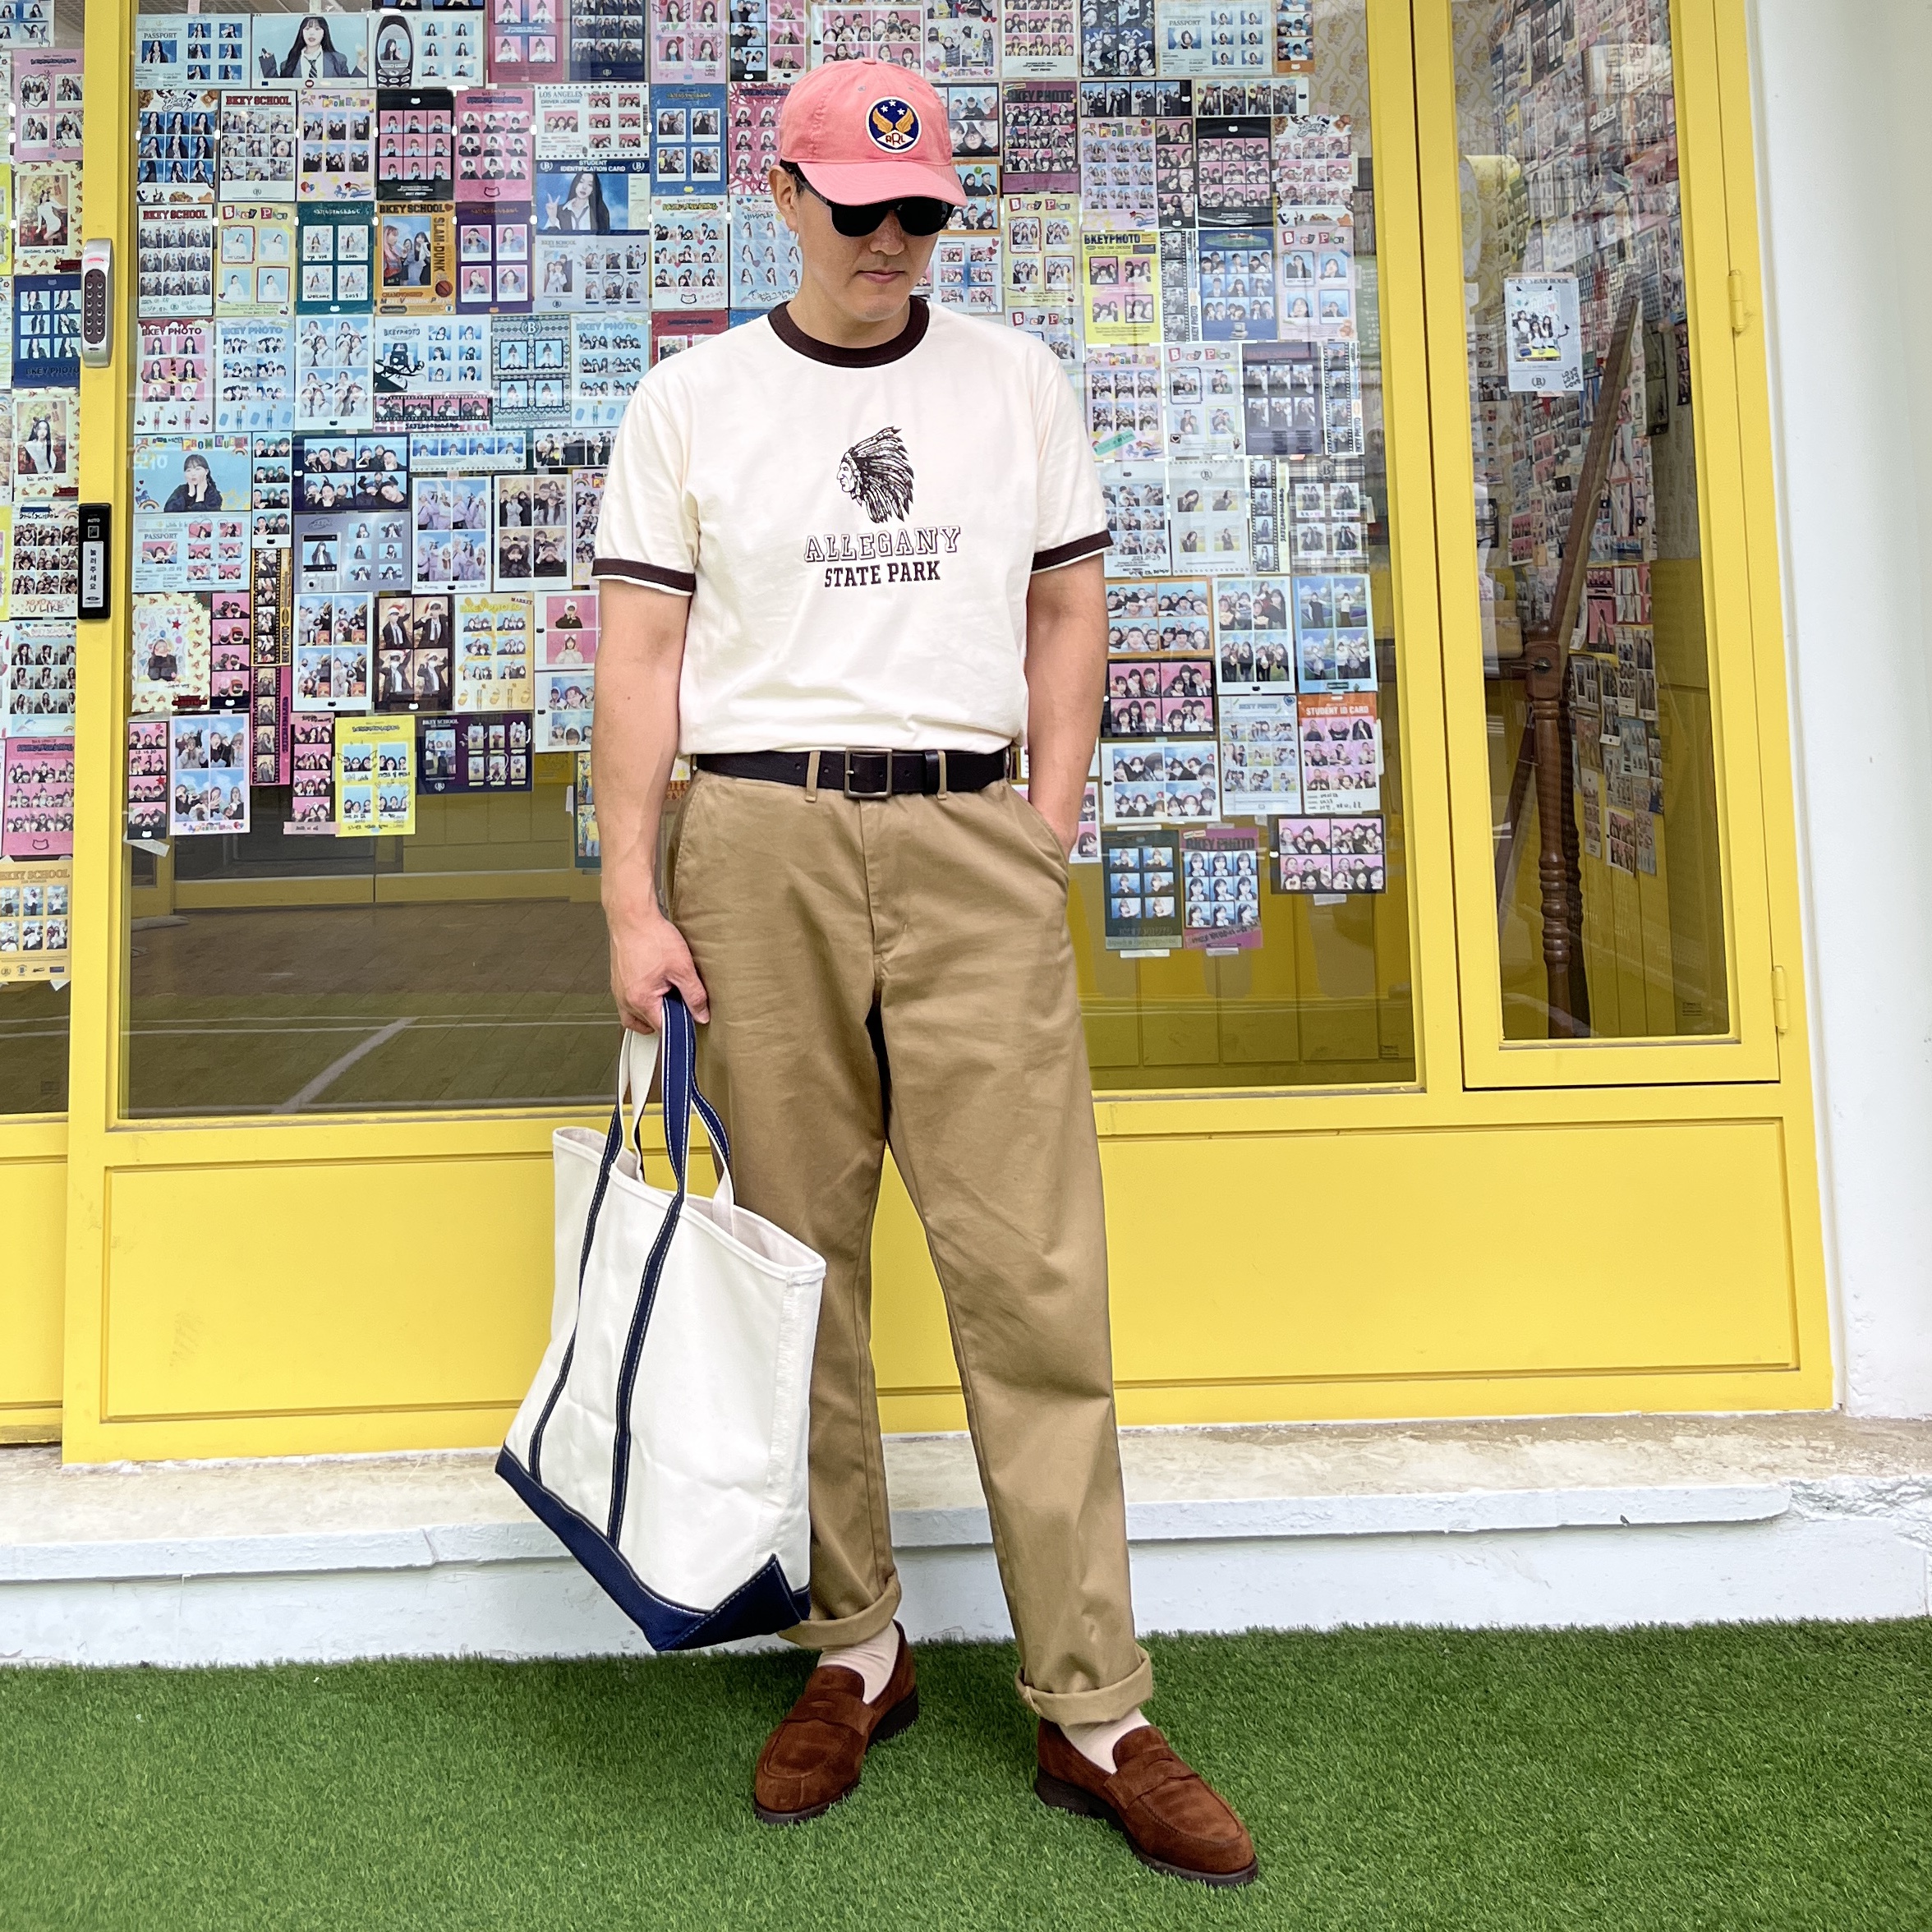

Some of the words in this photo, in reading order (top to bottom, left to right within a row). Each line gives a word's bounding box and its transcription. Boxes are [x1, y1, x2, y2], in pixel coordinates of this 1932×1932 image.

[225, 96, 253, 105] BKEY
[254, 96, 292, 105] SCHOOL
[886, 132, 905, 145] ARL
[143, 210, 170, 220] BKEY
[171, 209, 208, 219] SCHOOL
[379, 205, 406, 214] BKEY
[407, 204, 445, 213] SCHOOL
[1083, 233, 1140, 246] BKEYPHOTO
[248, 326, 283, 334] PHOTO
[603, 321, 637, 330] PHOTO
[141, 328, 166, 337] BKEY
[168, 327, 202, 336] PHOTO
[182, 438, 214, 451] PROM
[804, 525, 961, 563] ALLEGANY
[824, 564, 882, 588] STATE
[886, 560, 941, 582] PARK
[39, 604, 65, 613] LIKE
[1305, 706, 1338, 716] STUDENT
[1340, 706, 1348, 715] ID
[1349, 705, 1369, 715] CARD
[27, 869, 71, 880] SCHOOL
